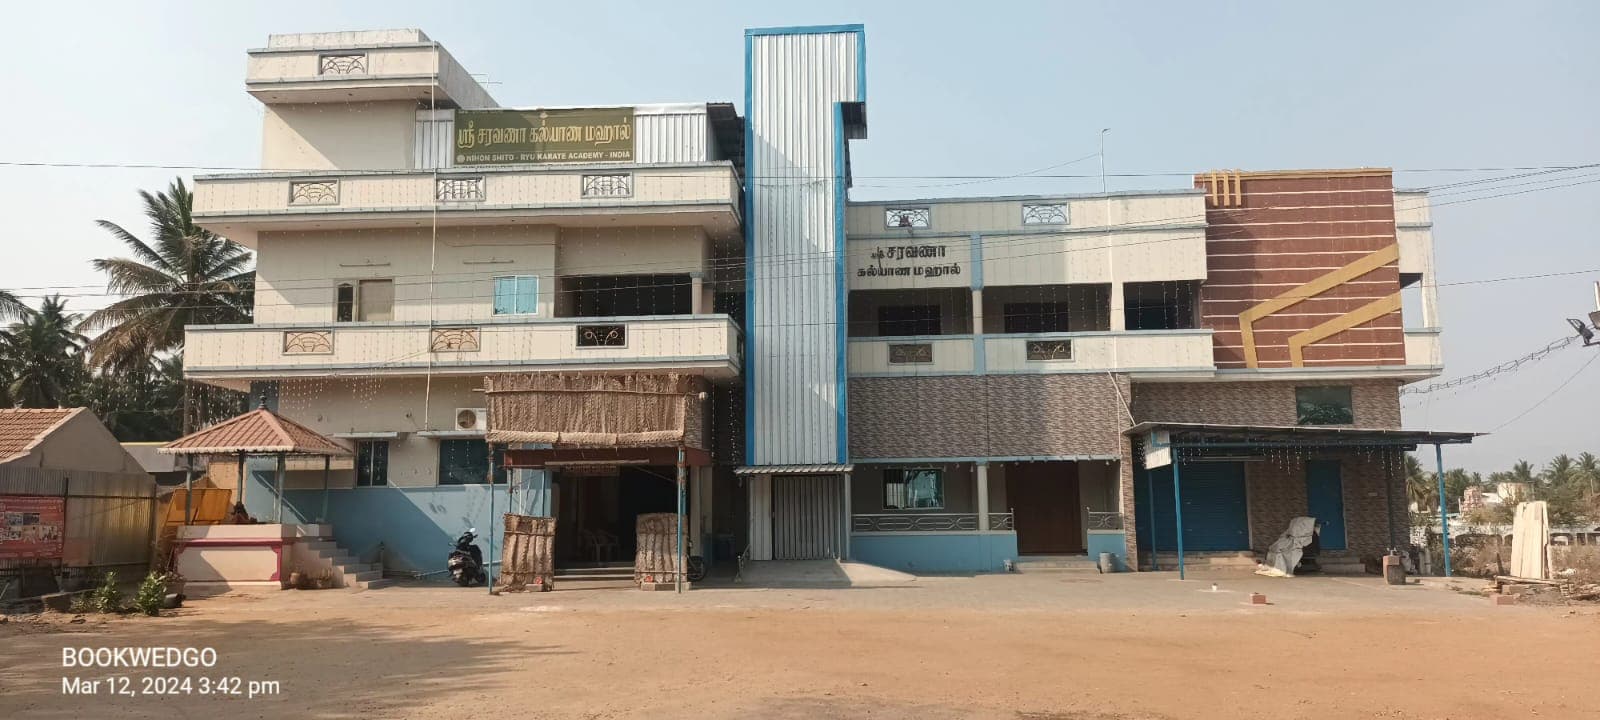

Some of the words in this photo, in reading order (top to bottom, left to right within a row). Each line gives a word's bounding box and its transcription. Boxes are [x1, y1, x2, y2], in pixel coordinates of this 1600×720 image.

[458, 120, 475, 149] ஸ்ரீ
[477, 127, 526, 147] சரவணா
[529, 119, 583, 143] கல்யாண
[585, 116, 632, 147] மஹால்
[466, 154, 490, 162] NIHON
[491, 154, 514, 162] SHITO
[520, 153, 536, 161] RYU
[537, 152, 567, 161] KARATE
[568, 151, 604, 160] ACADEMY
[609, 151, 631, 159] INDIA
[886, 245, 946, 260] சரவணா
[857, 264, 910, 277] கல்யாண
[913, 262, 961, 278] மஹால்
